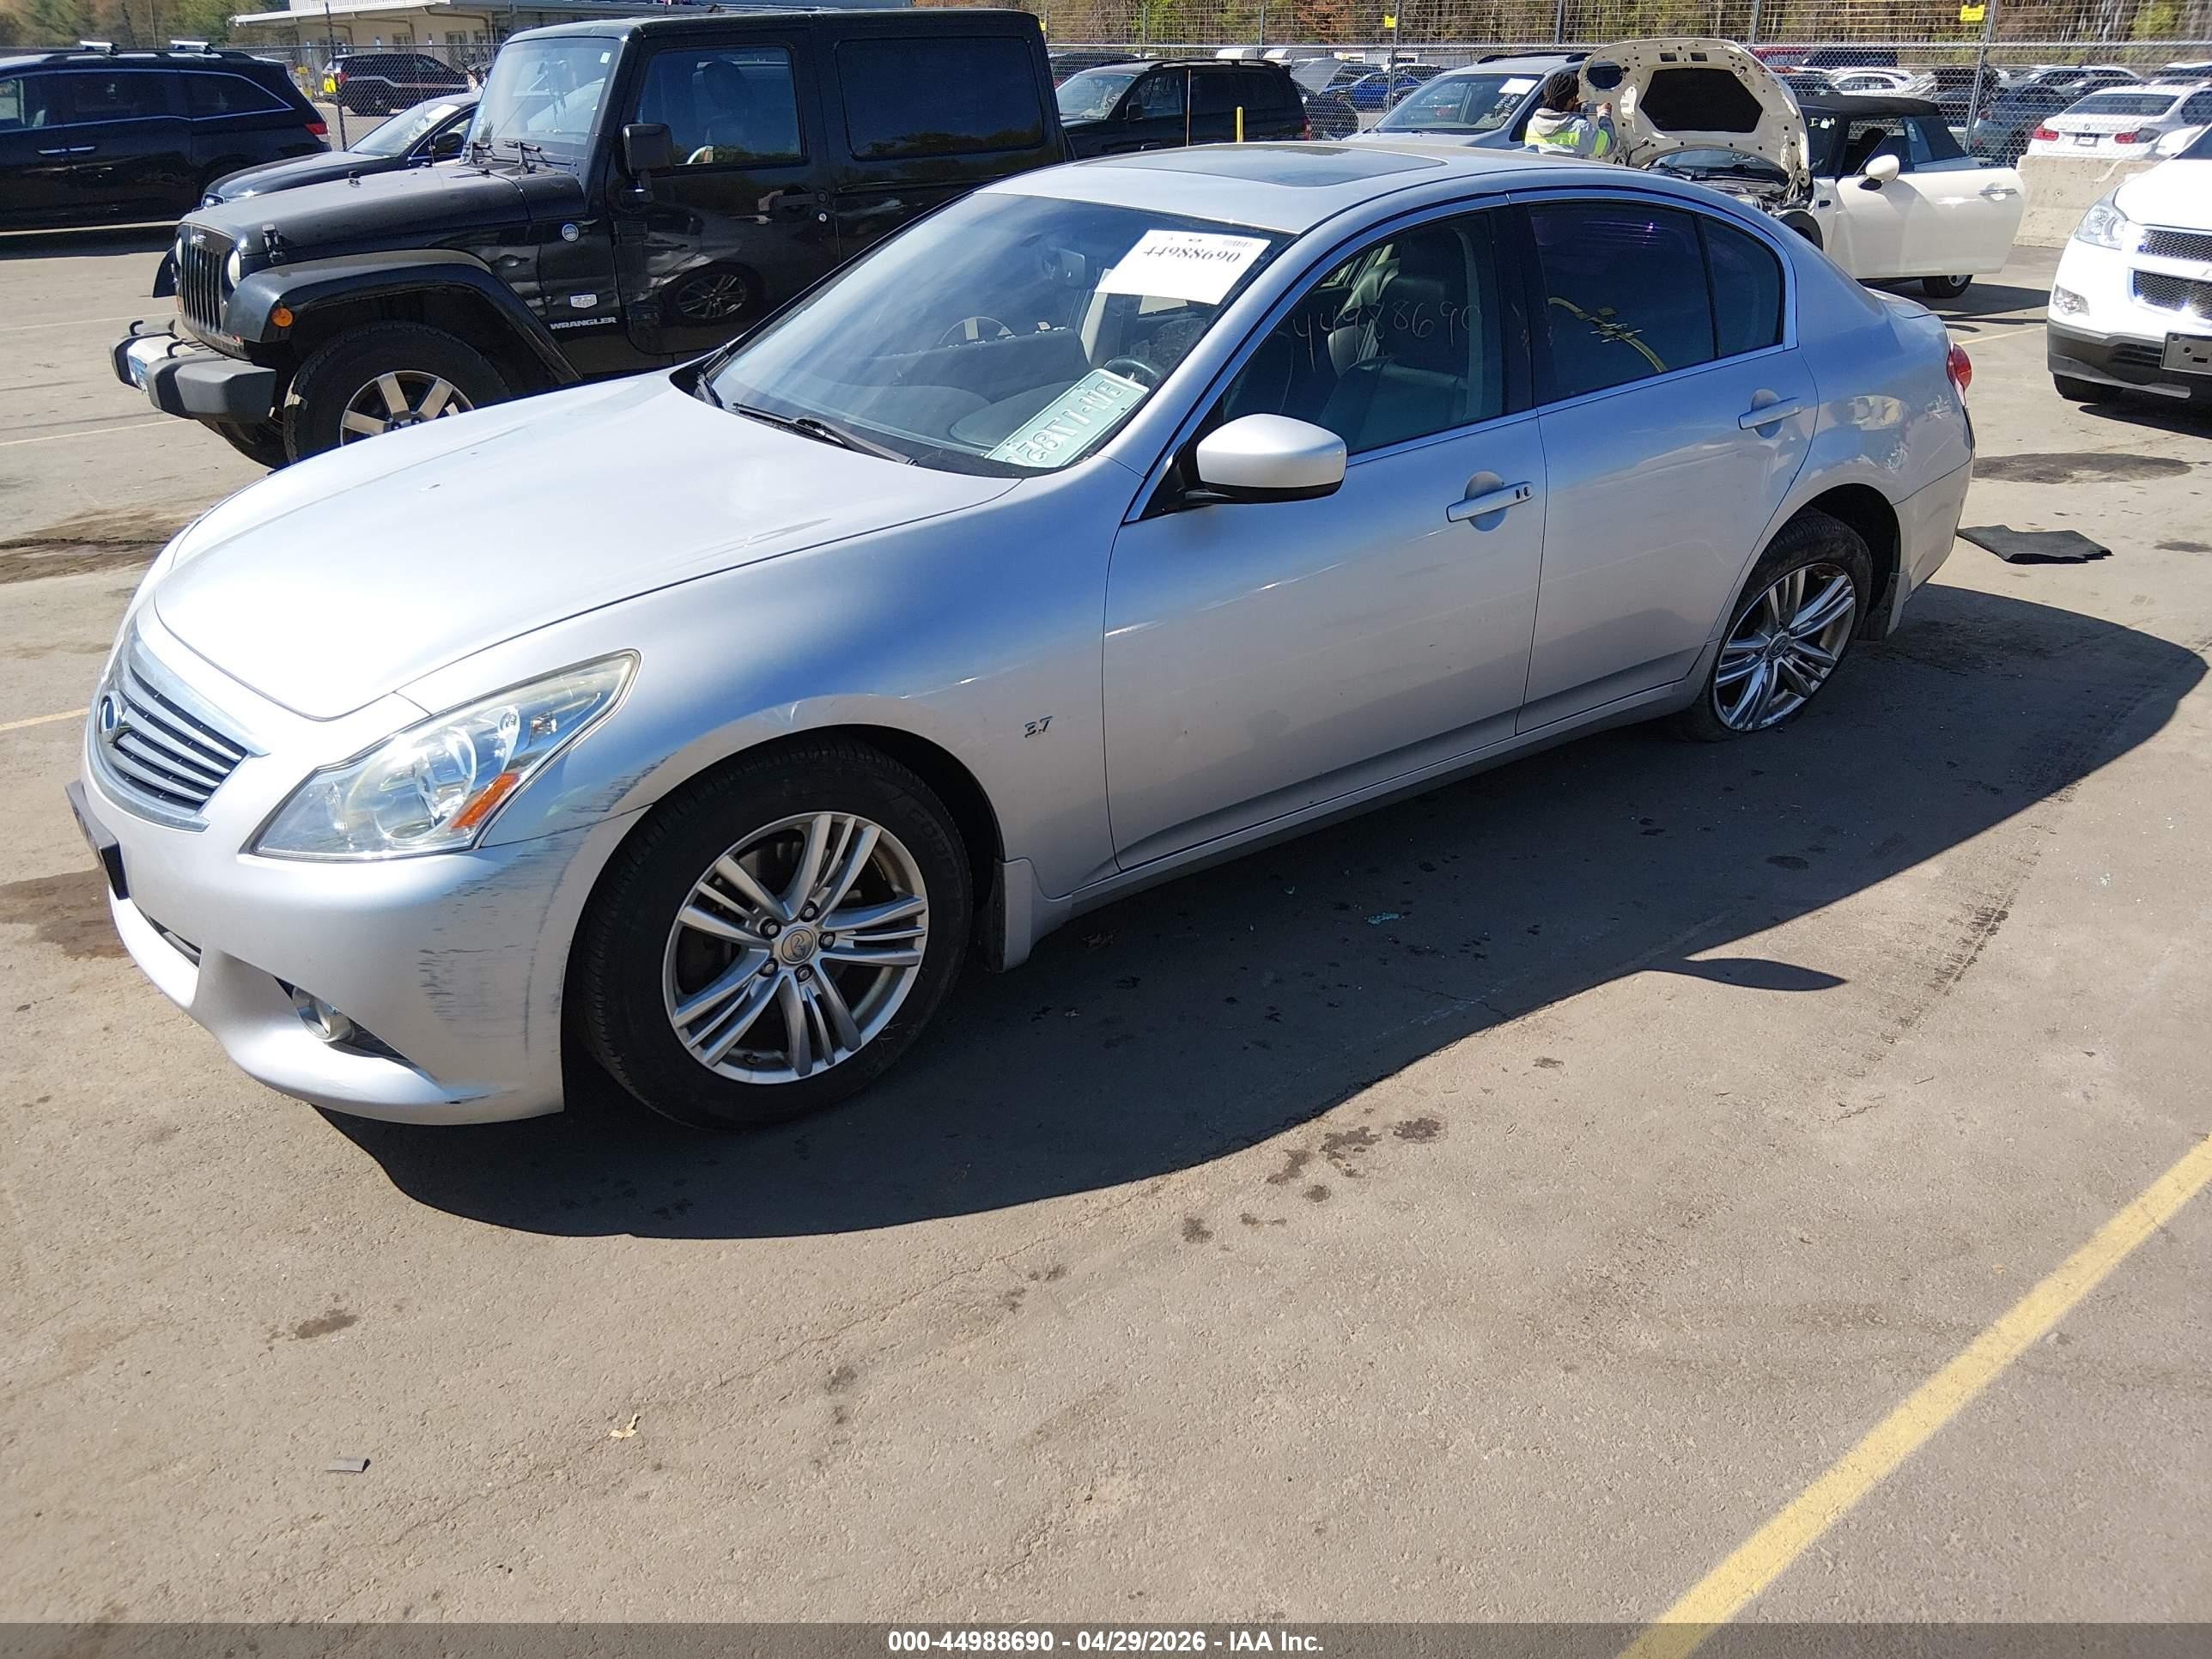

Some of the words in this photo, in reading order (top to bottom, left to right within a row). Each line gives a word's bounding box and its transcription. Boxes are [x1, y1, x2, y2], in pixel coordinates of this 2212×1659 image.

[1143, 246, 1241, 263] 44988690
[550, 316, 618, 331] WRANGLER
[1024, 715, 1054, 738] 3.7
